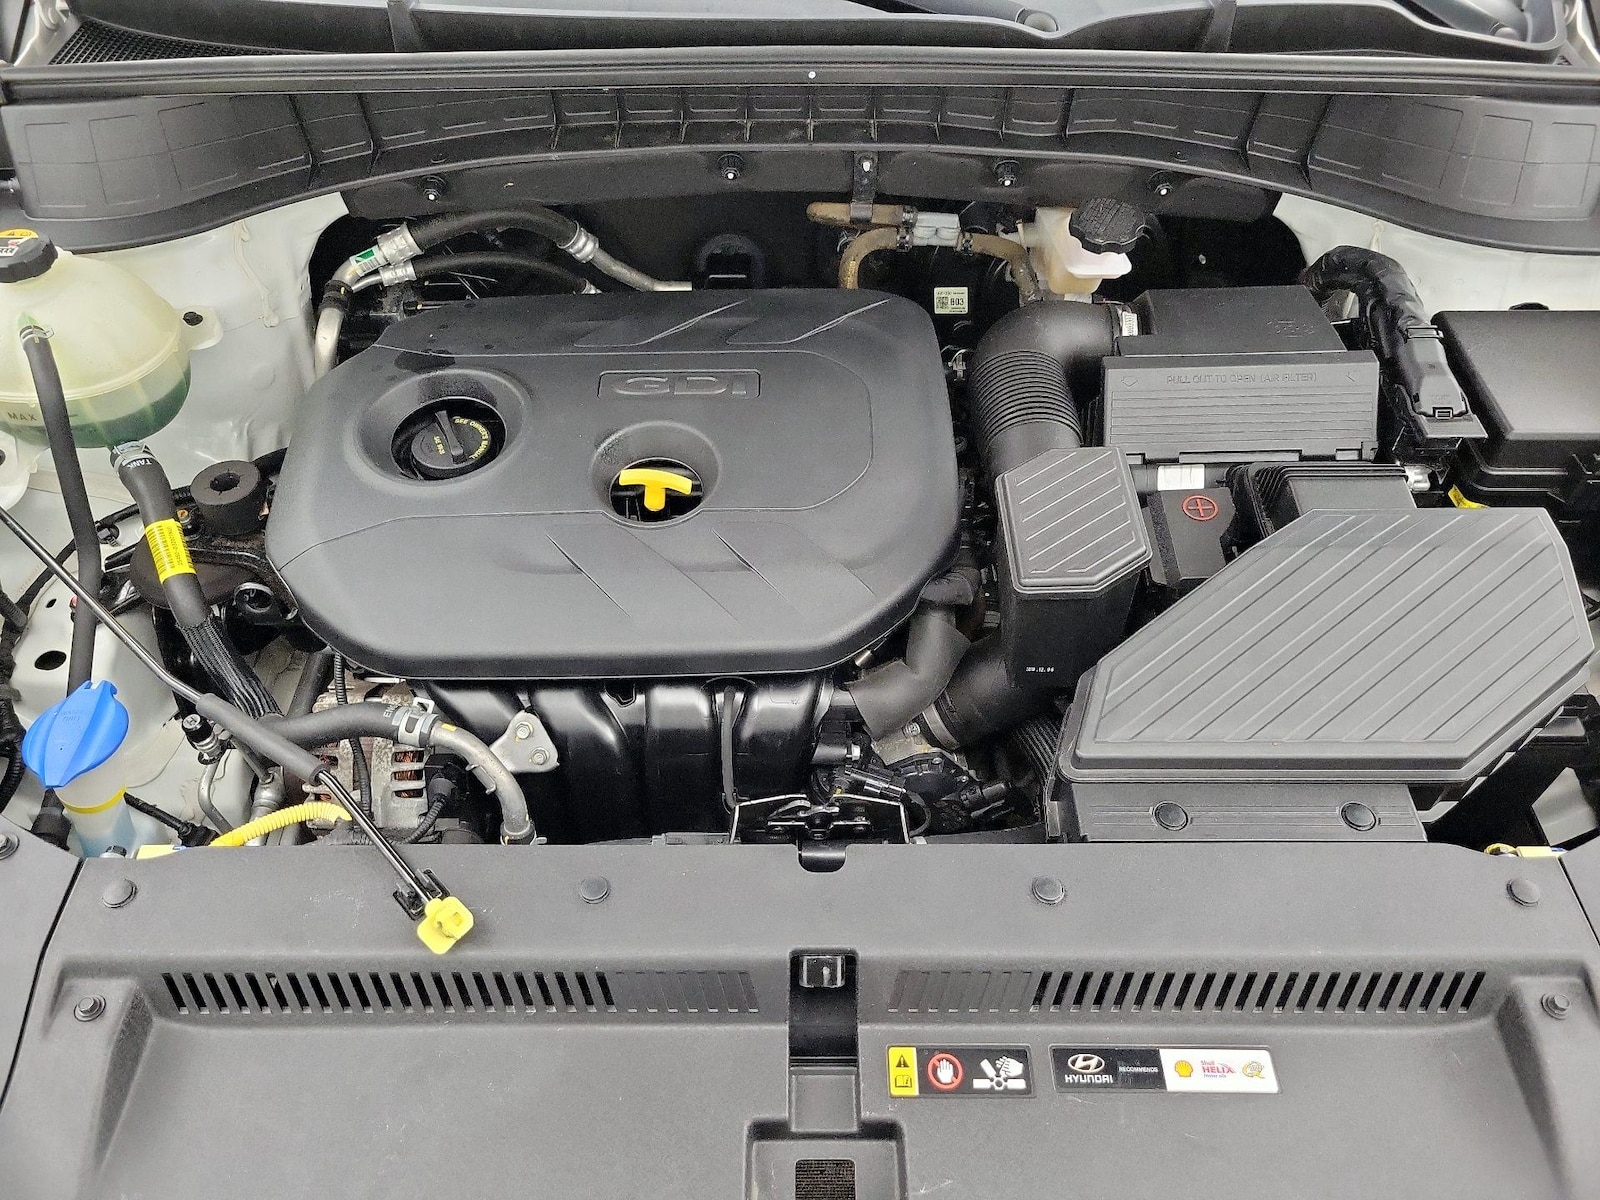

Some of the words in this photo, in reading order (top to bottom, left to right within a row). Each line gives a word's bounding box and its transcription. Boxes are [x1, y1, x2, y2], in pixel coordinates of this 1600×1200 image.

[1166, 375, 1191, 384] PULL
[1193, 375, 1213, 383] OUT
[1215, 374, 1226, 383] TO
[1230, 374, 1256, 382] OPEN
[7, 411, 38, 421] MAX
[1202, 1066, 1236, 1074] HELIX
[1064, 1074, 1114, 1084] HYUNDAI
